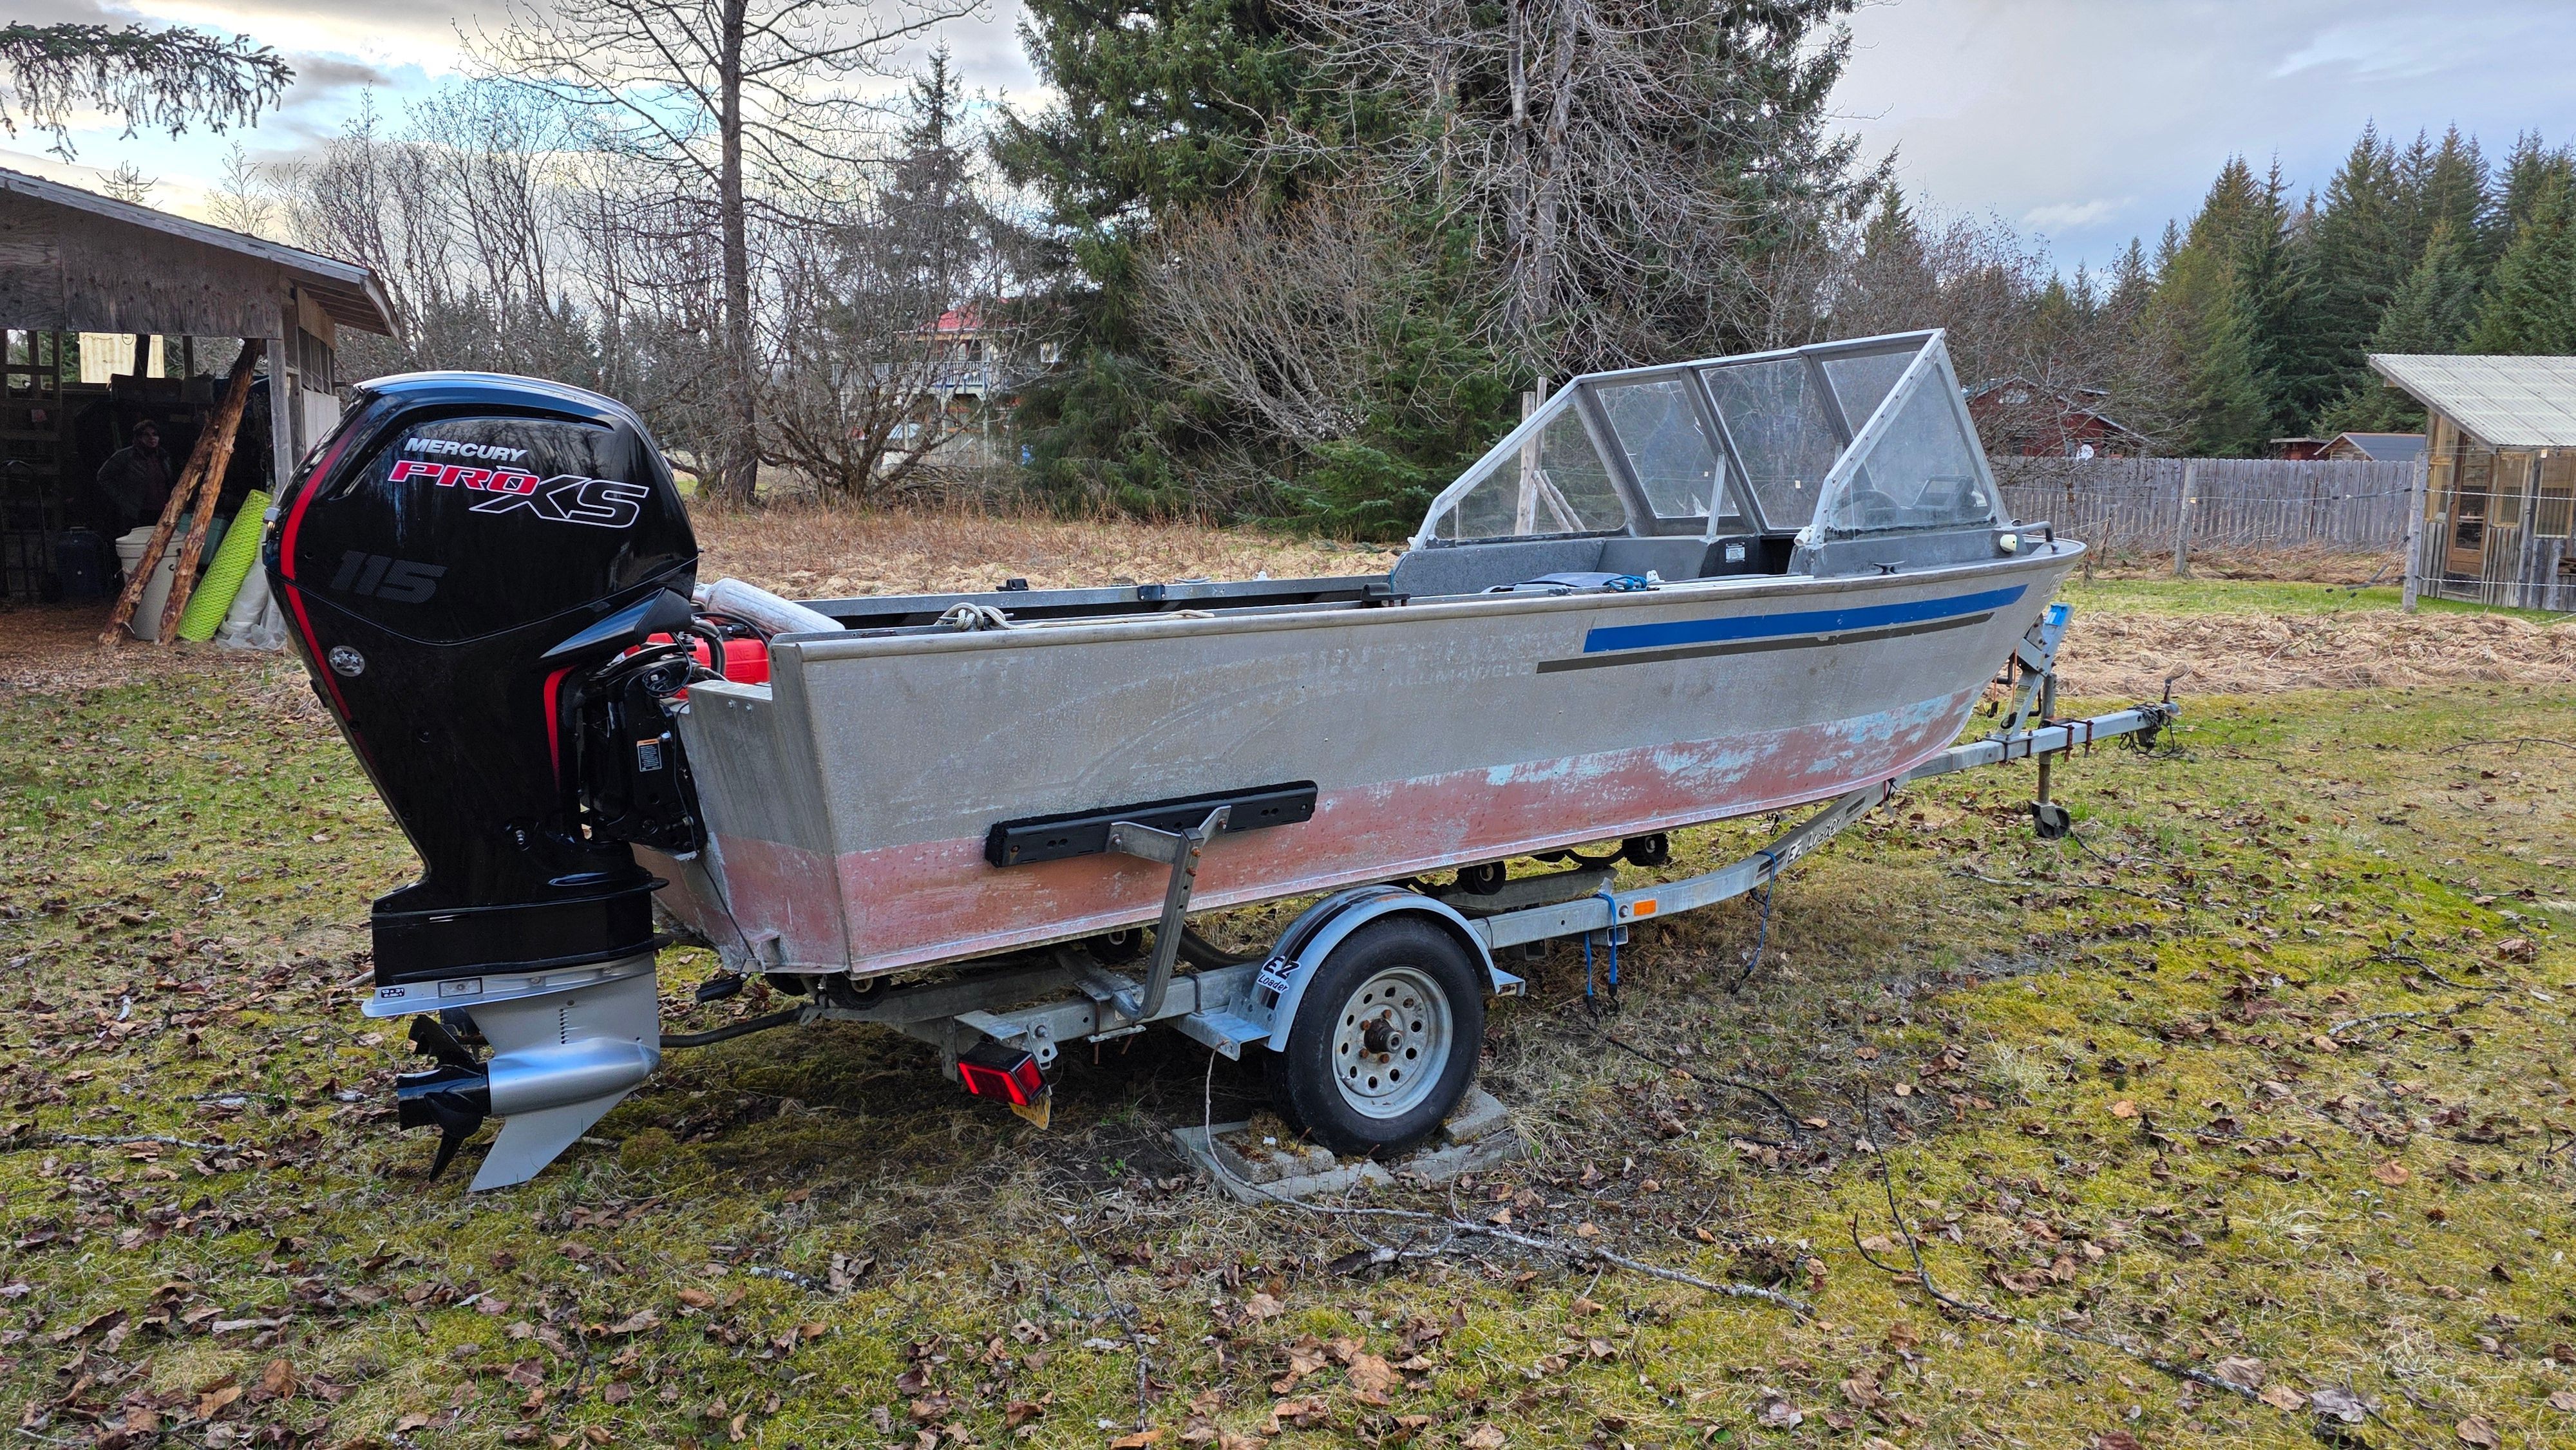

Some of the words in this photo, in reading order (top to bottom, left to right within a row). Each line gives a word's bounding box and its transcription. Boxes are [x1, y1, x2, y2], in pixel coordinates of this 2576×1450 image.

[404, 437, 528, 462] MERCURY
[388, 460, 541, 496] PRO
[469, 466, 649, 529] XS
[330, 550, 448, 604] 115
[1786, 840, 1803, 864] EZ
[1263, 956, 1300, 981] EZ
[1257, 974, 1289, 992] Loader
